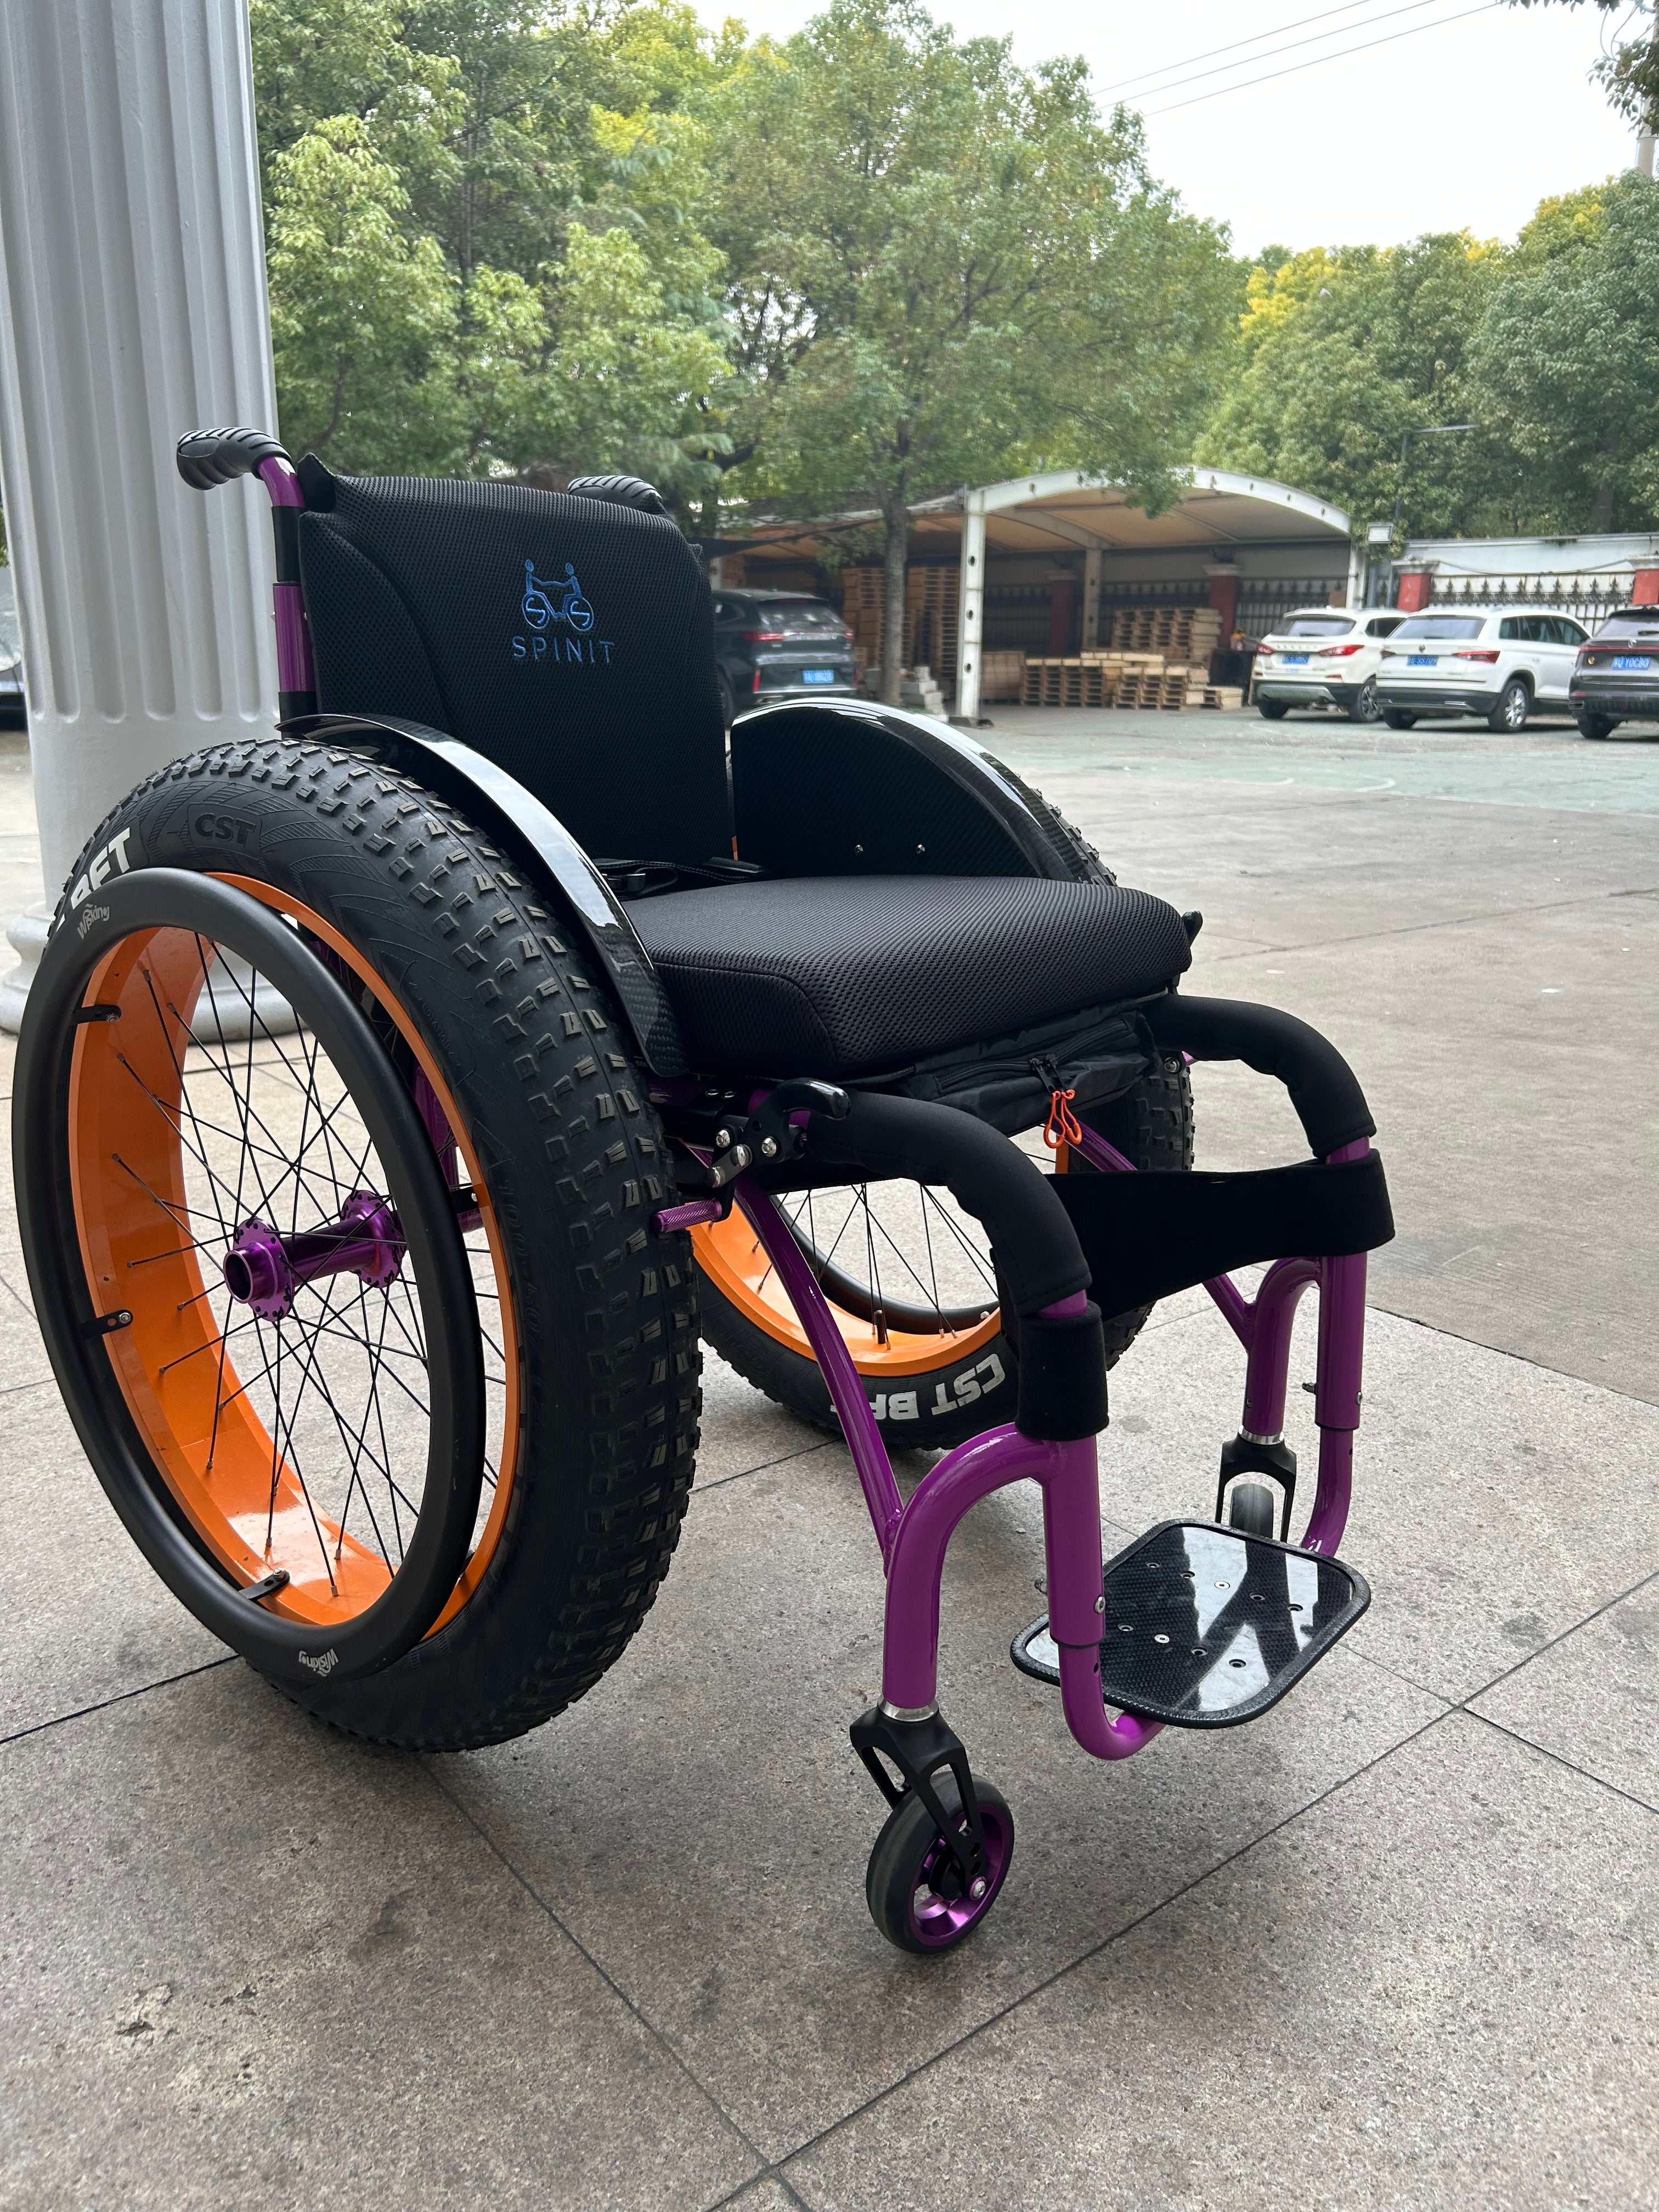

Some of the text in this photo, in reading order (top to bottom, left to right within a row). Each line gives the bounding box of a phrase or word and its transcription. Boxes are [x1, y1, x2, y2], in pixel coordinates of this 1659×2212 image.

[512, 636, 614, 663] SPINIT
[195, 812, 256, 847] CST
[931, 1353, 1005, 1415] CST
